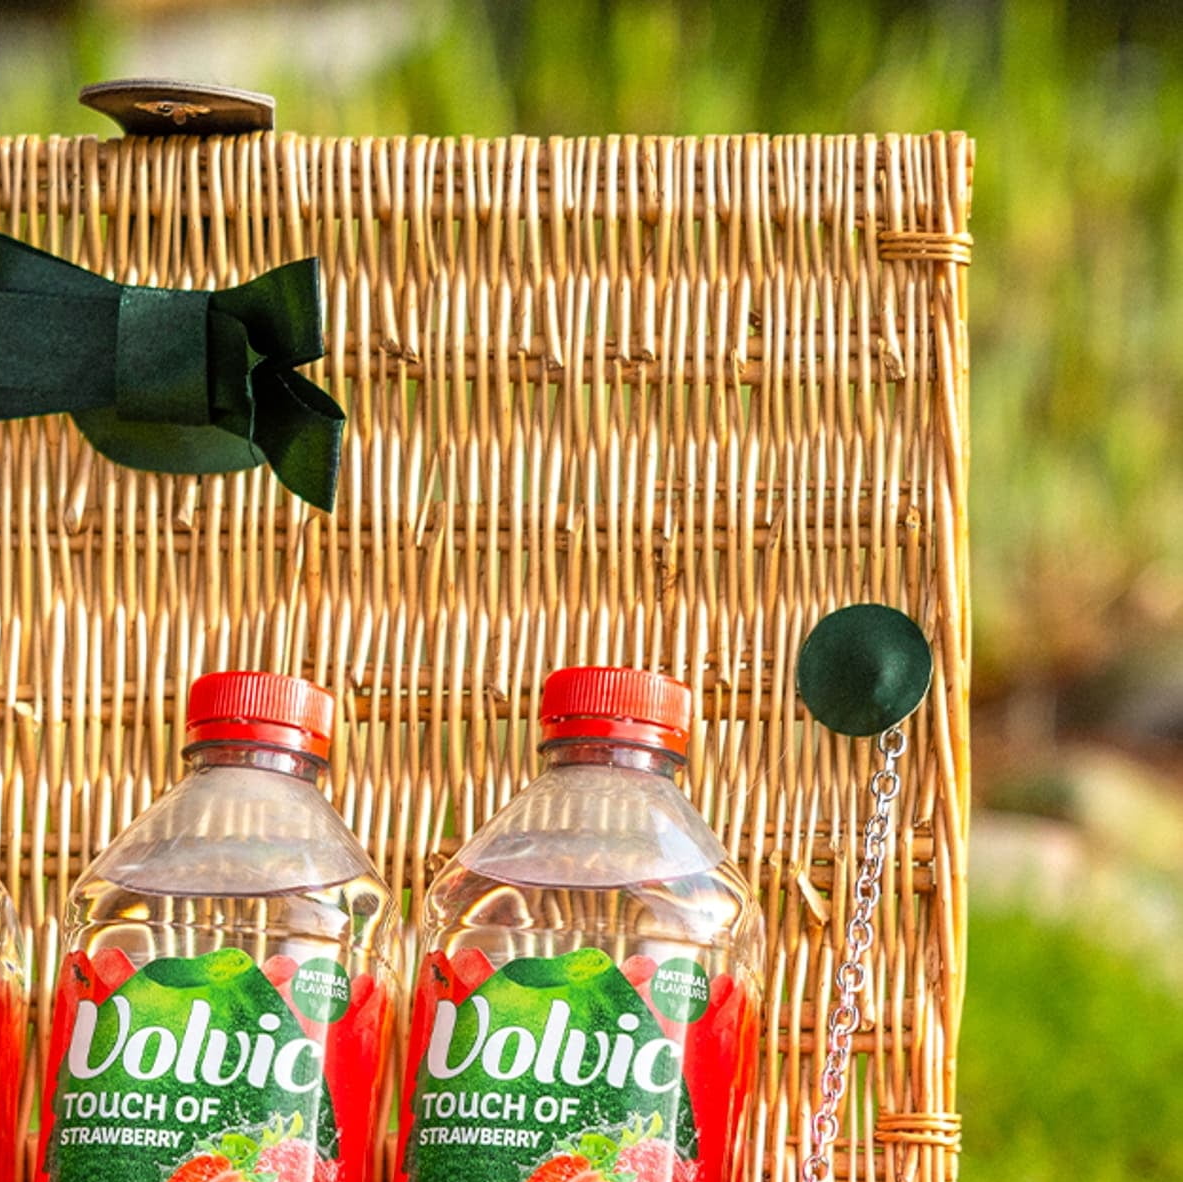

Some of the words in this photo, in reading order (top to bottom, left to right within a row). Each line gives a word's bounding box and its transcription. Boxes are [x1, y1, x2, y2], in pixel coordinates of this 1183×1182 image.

[298, 968, 348, 988] NATURAL
[657, 968, 707, 988] NATURAL
[295, 980, 348, 1001] FLAVOURS
[654, 980, 707, 1001] FLAVOURS
[68, 995, 322, 1092] Volvic
[427, 995, 681, 1092] Volvic
[63, 1092, 166, 1121] TOUCH
[174, 1096, 220, 1124] OF
[422, 1092, 526, 1121] TOUCH
[533, 1096, 580, 1124] OF
[60, 1128, 184, 1149] STRAWBERRY
[419, 1128, 543, 1149] STRAWBERRY
